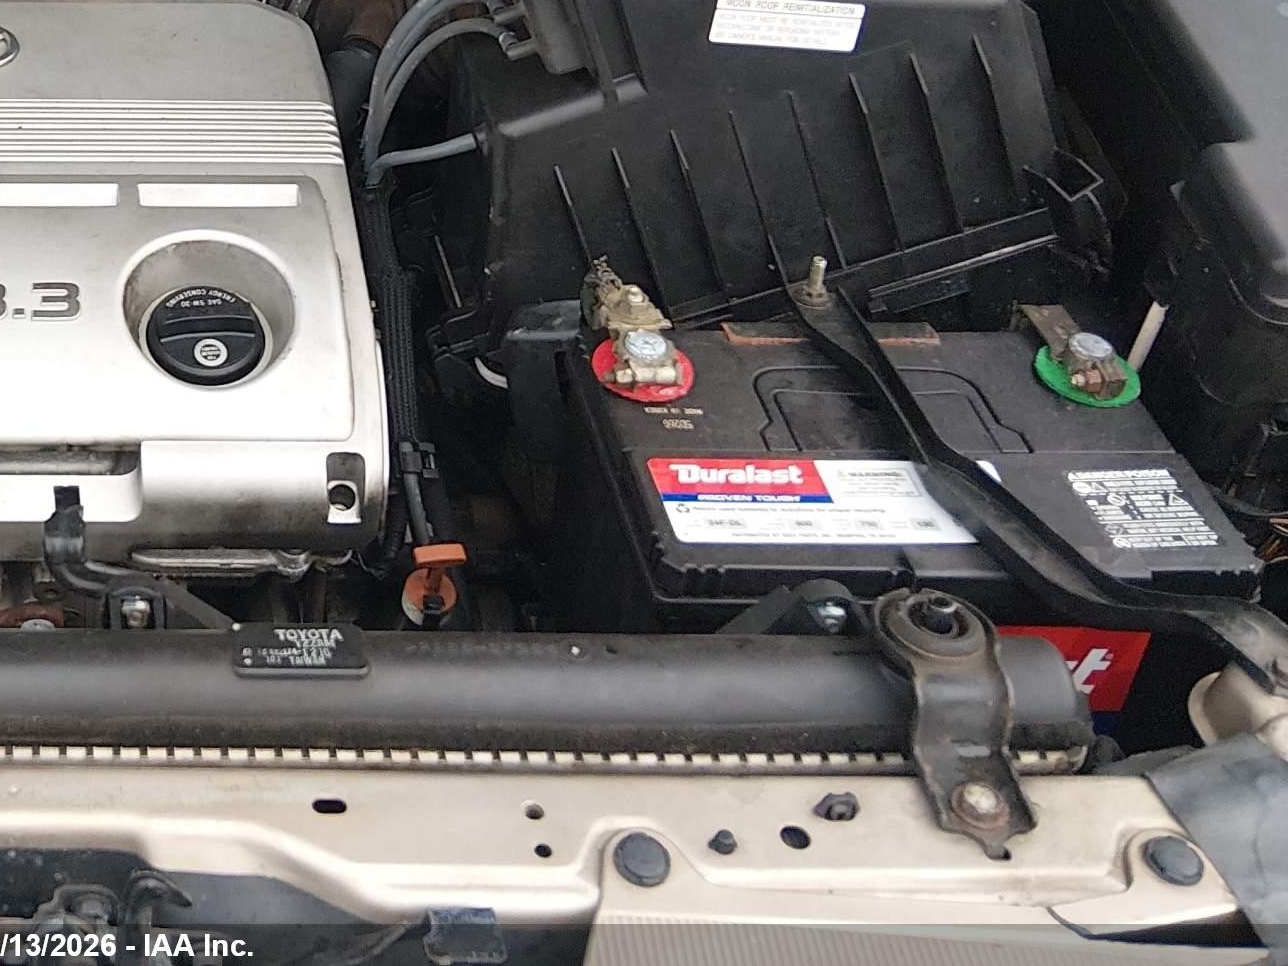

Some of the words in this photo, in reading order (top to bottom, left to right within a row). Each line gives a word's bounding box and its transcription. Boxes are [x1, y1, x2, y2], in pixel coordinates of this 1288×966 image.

[755, 0, 780, 11] ROOF
[783, 2, 856, 15] REINITIALIZATION
[669, 462, 804, 485] Duralast
[274, 628, 344, 642] TOYOTA
